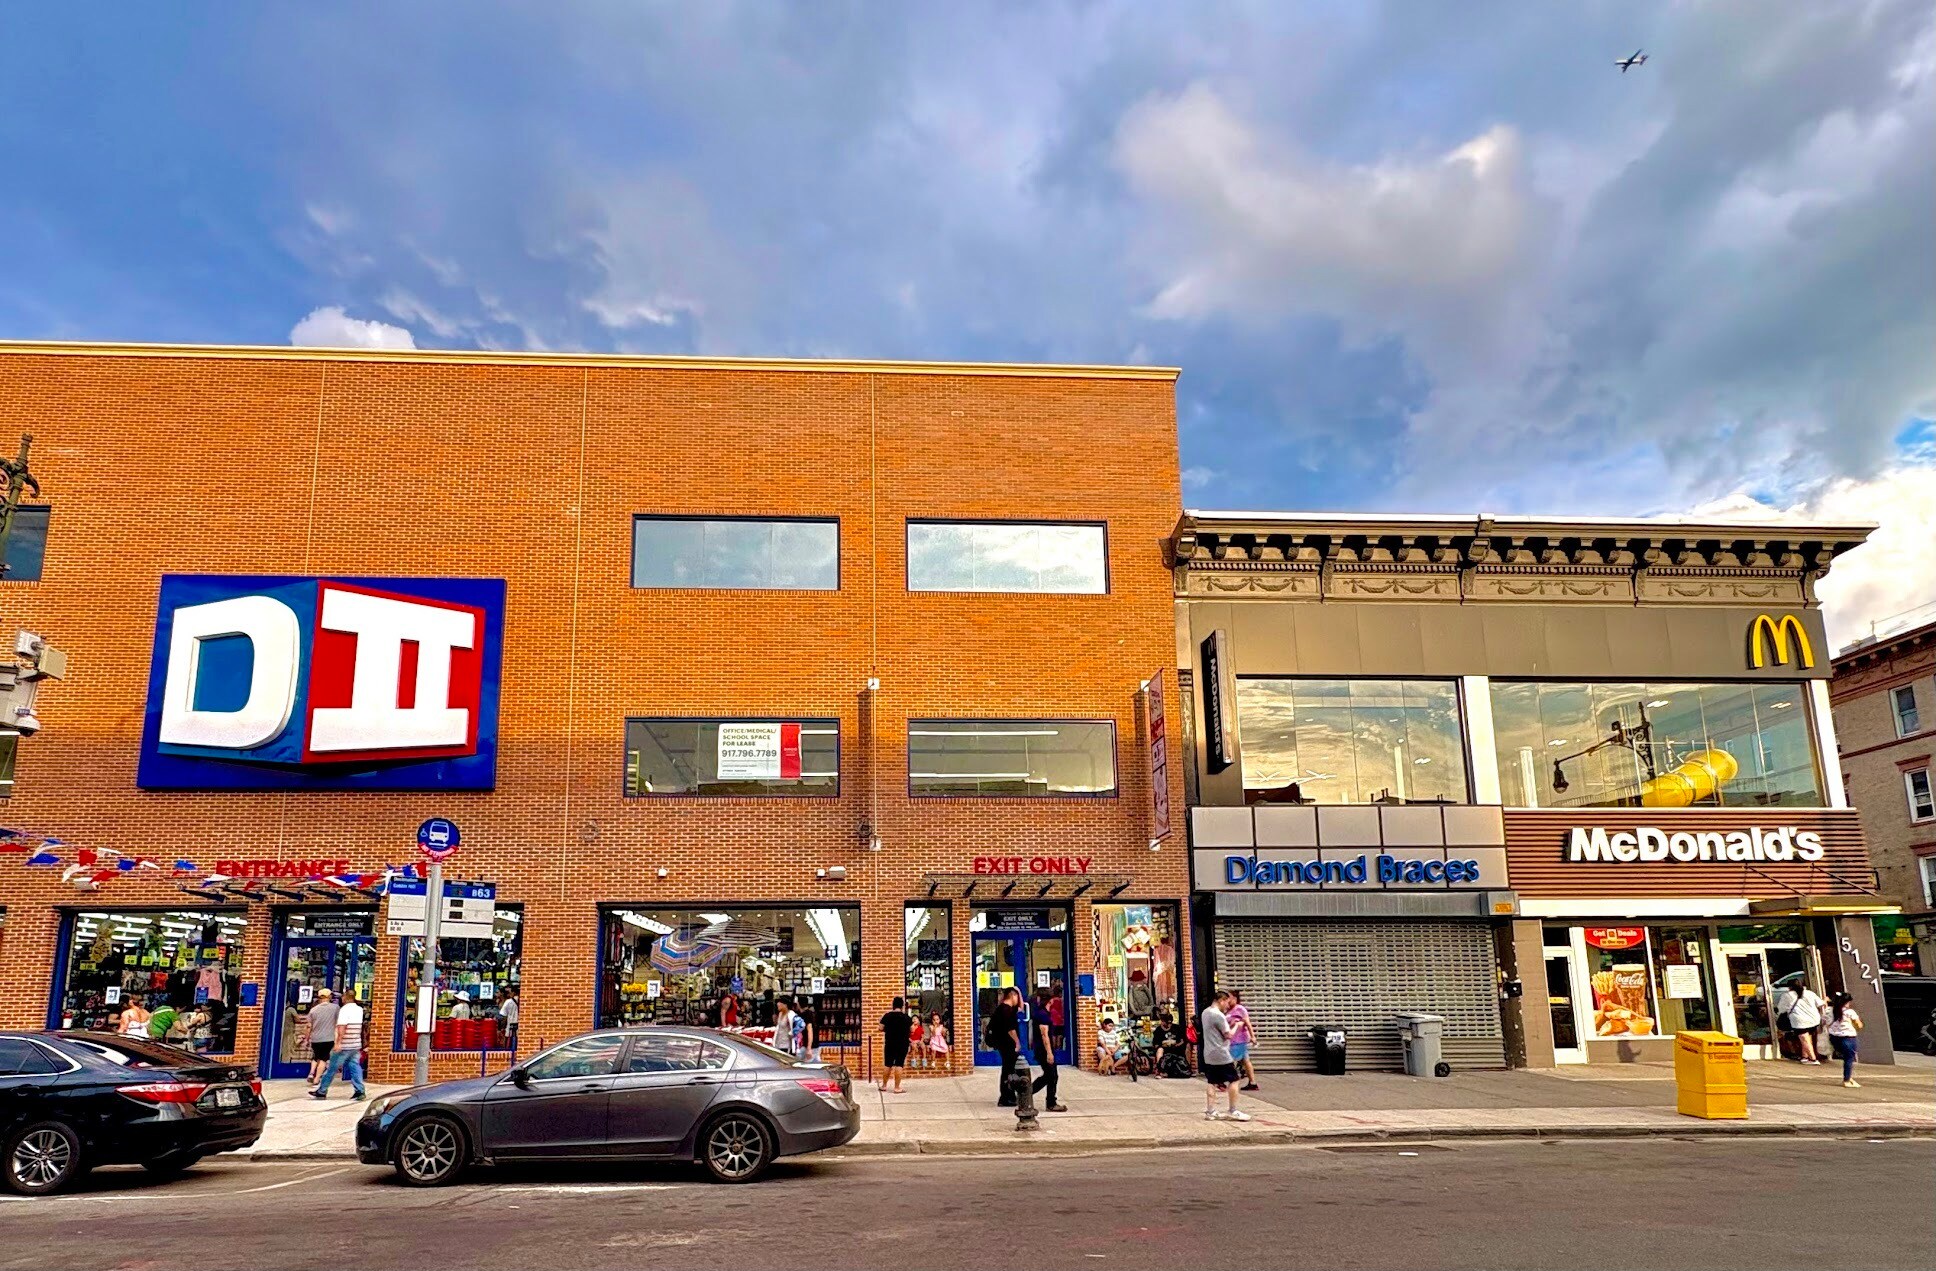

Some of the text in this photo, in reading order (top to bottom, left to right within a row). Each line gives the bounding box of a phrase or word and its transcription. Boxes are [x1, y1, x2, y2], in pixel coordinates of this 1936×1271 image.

[1209, 656, 1222, 756] McDonald's
[721, 750, 777, 758] 917.796.7789
[1569, 825, 1825, 862] McDonald's
[215, 859, 350, 877] ENTRANCE
[974, 857, 1092, 874] EXIT ONLY
[1225, 854, 1480, 885] Diamond Braces
[472, 888, 491, 898] B63
[1841, 937, 1880, 994] 5121
